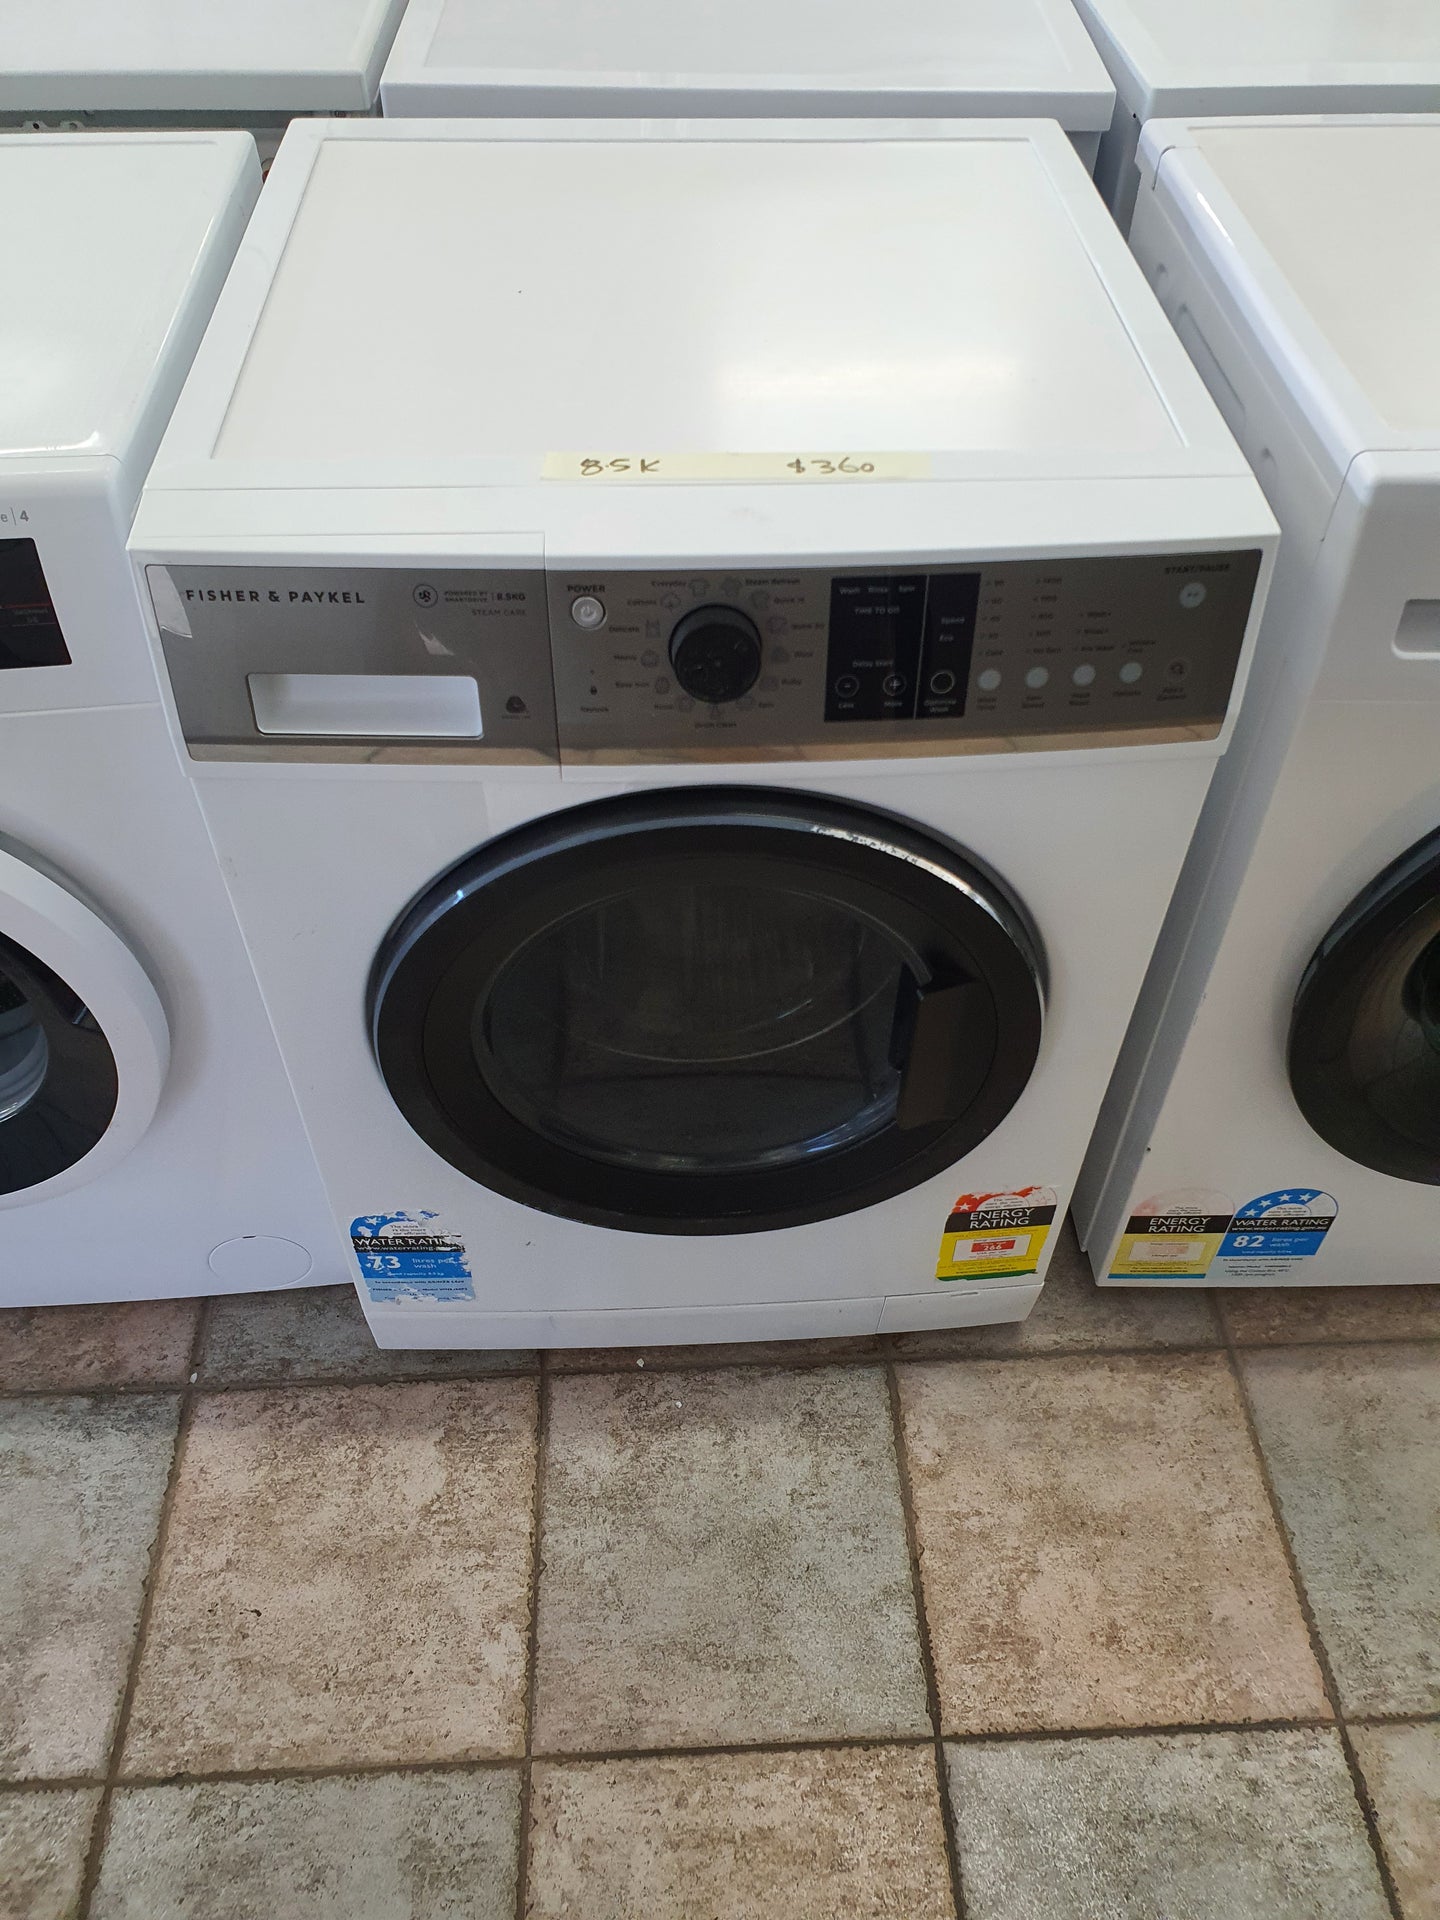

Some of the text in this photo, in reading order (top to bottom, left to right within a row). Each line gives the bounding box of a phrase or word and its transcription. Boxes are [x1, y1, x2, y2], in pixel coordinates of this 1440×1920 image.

[786, 456, 876, 475] $360
[566, 584, 606, 593] POWER
[185, 588, 366, 605] FISHER & PAYKEL
[471, 608, 501, 617] STEAM
[969, 1208, 1035, 1221] ENERGY
[968, 1217, 1030, 1229] RATING
[1149, 1217, 1212, 1225] ENERGY
[1280, 1218, 1330, 1226] RATING
[1148, 1225, 1206, 1233] RATING
[353, 1237, 449, 1247] WATER RATIN
[1232, 1235, 1265, 1248] 82
[366, 1255, 401, 1270] 73
